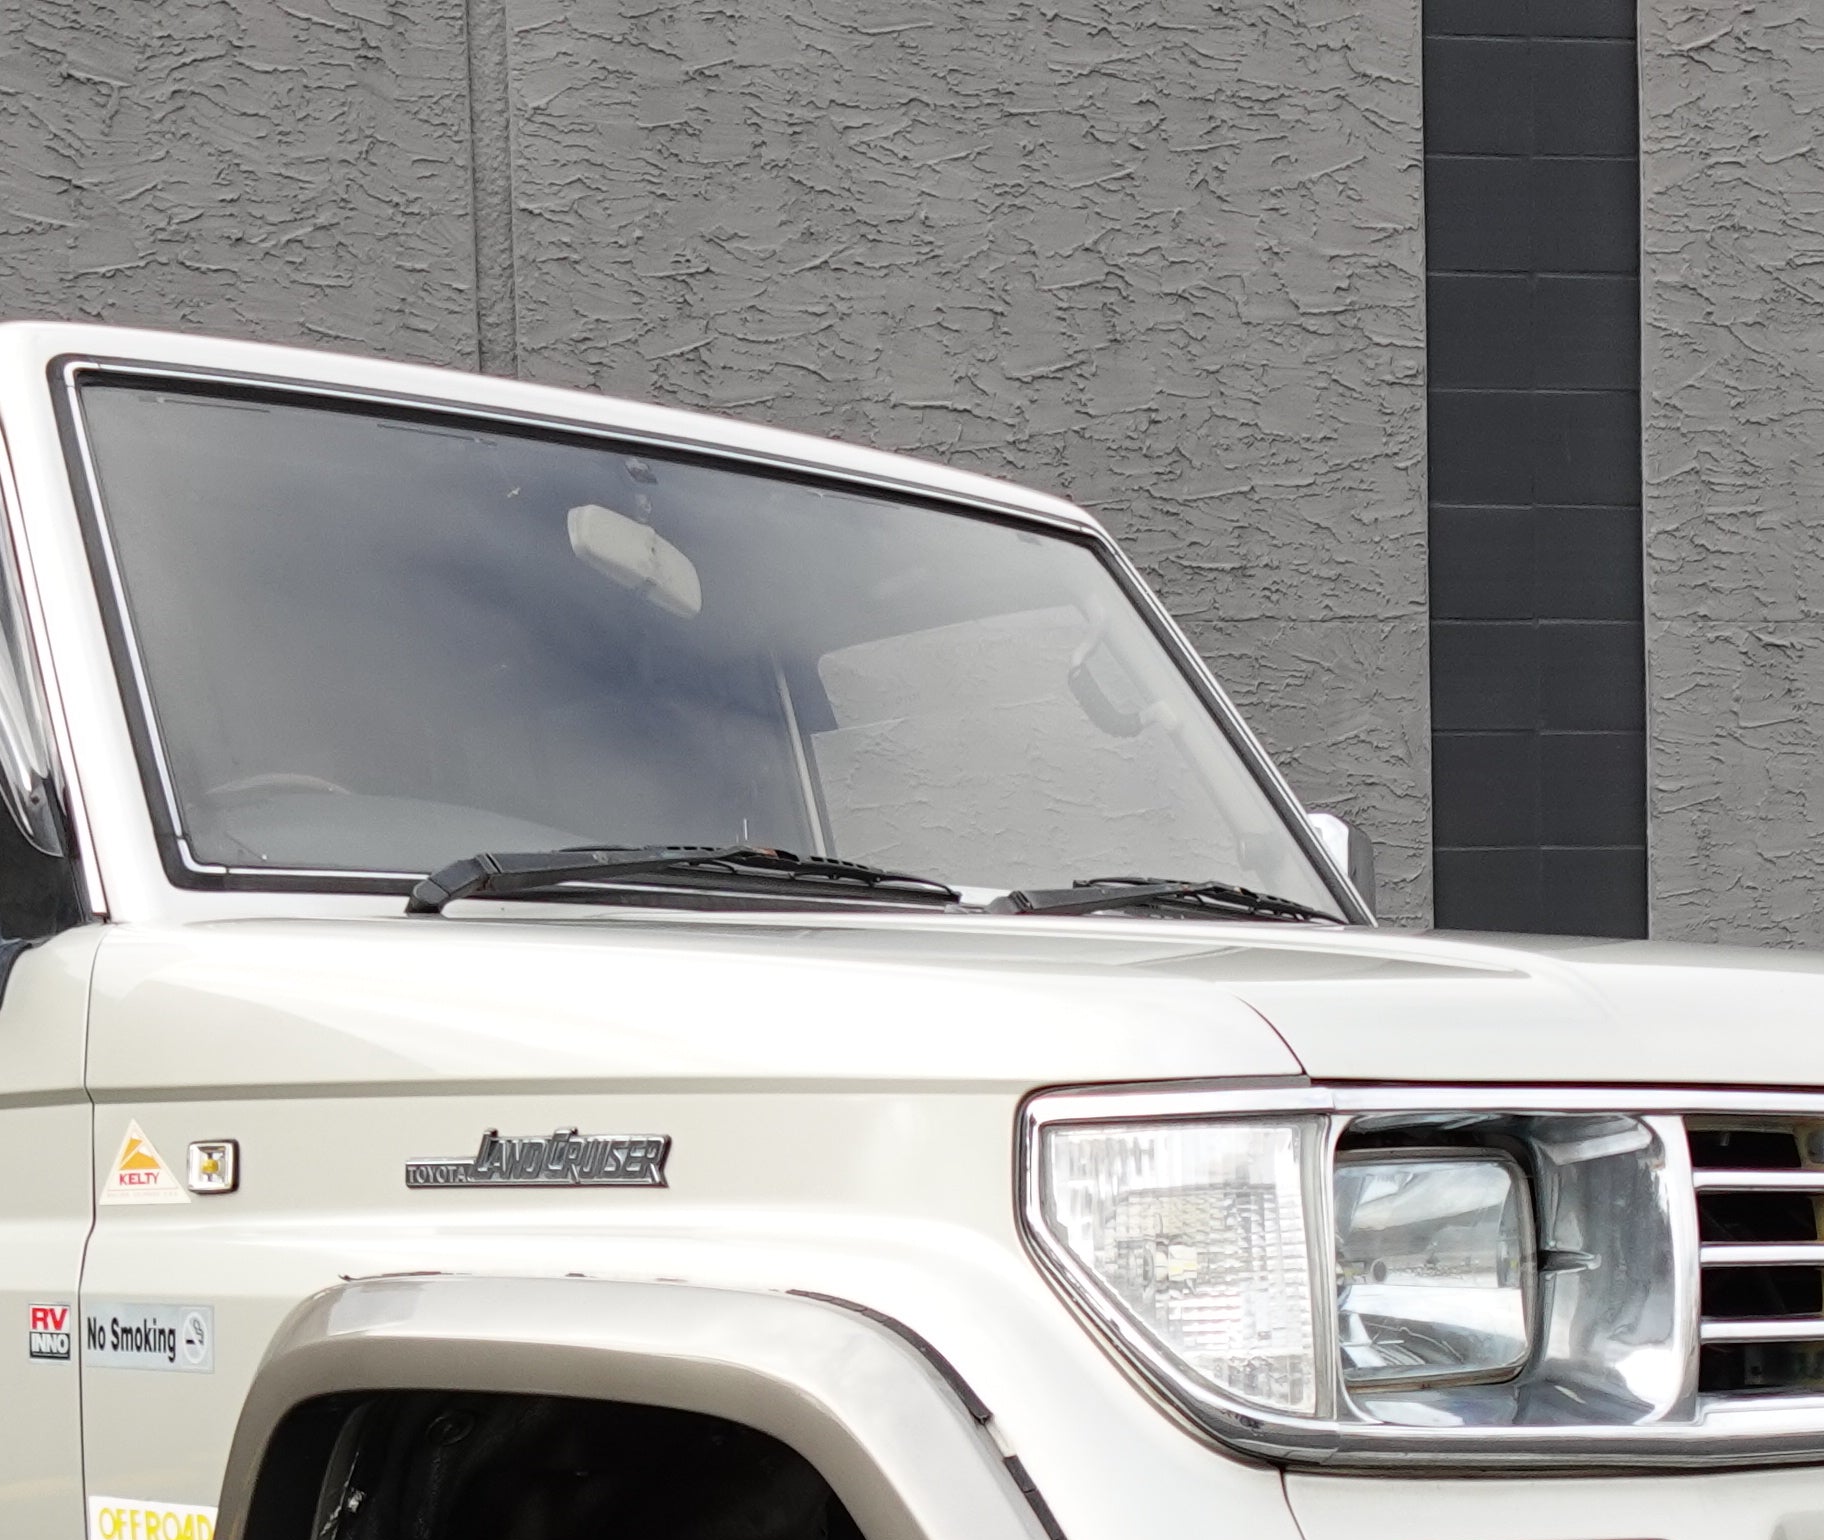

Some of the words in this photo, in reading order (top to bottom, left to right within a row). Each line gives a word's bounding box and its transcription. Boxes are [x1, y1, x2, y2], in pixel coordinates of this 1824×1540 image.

[119, 1172, 160, 1185] KELTY
[407, 1165, 468, 1184] TOYOTA
[31, 1307, 68, 1331] RV
[31, 1333, 69, 1354] INNO
[87, 1317, 106, 1351] No
[111, 1317, 176, 1363] Smoking
